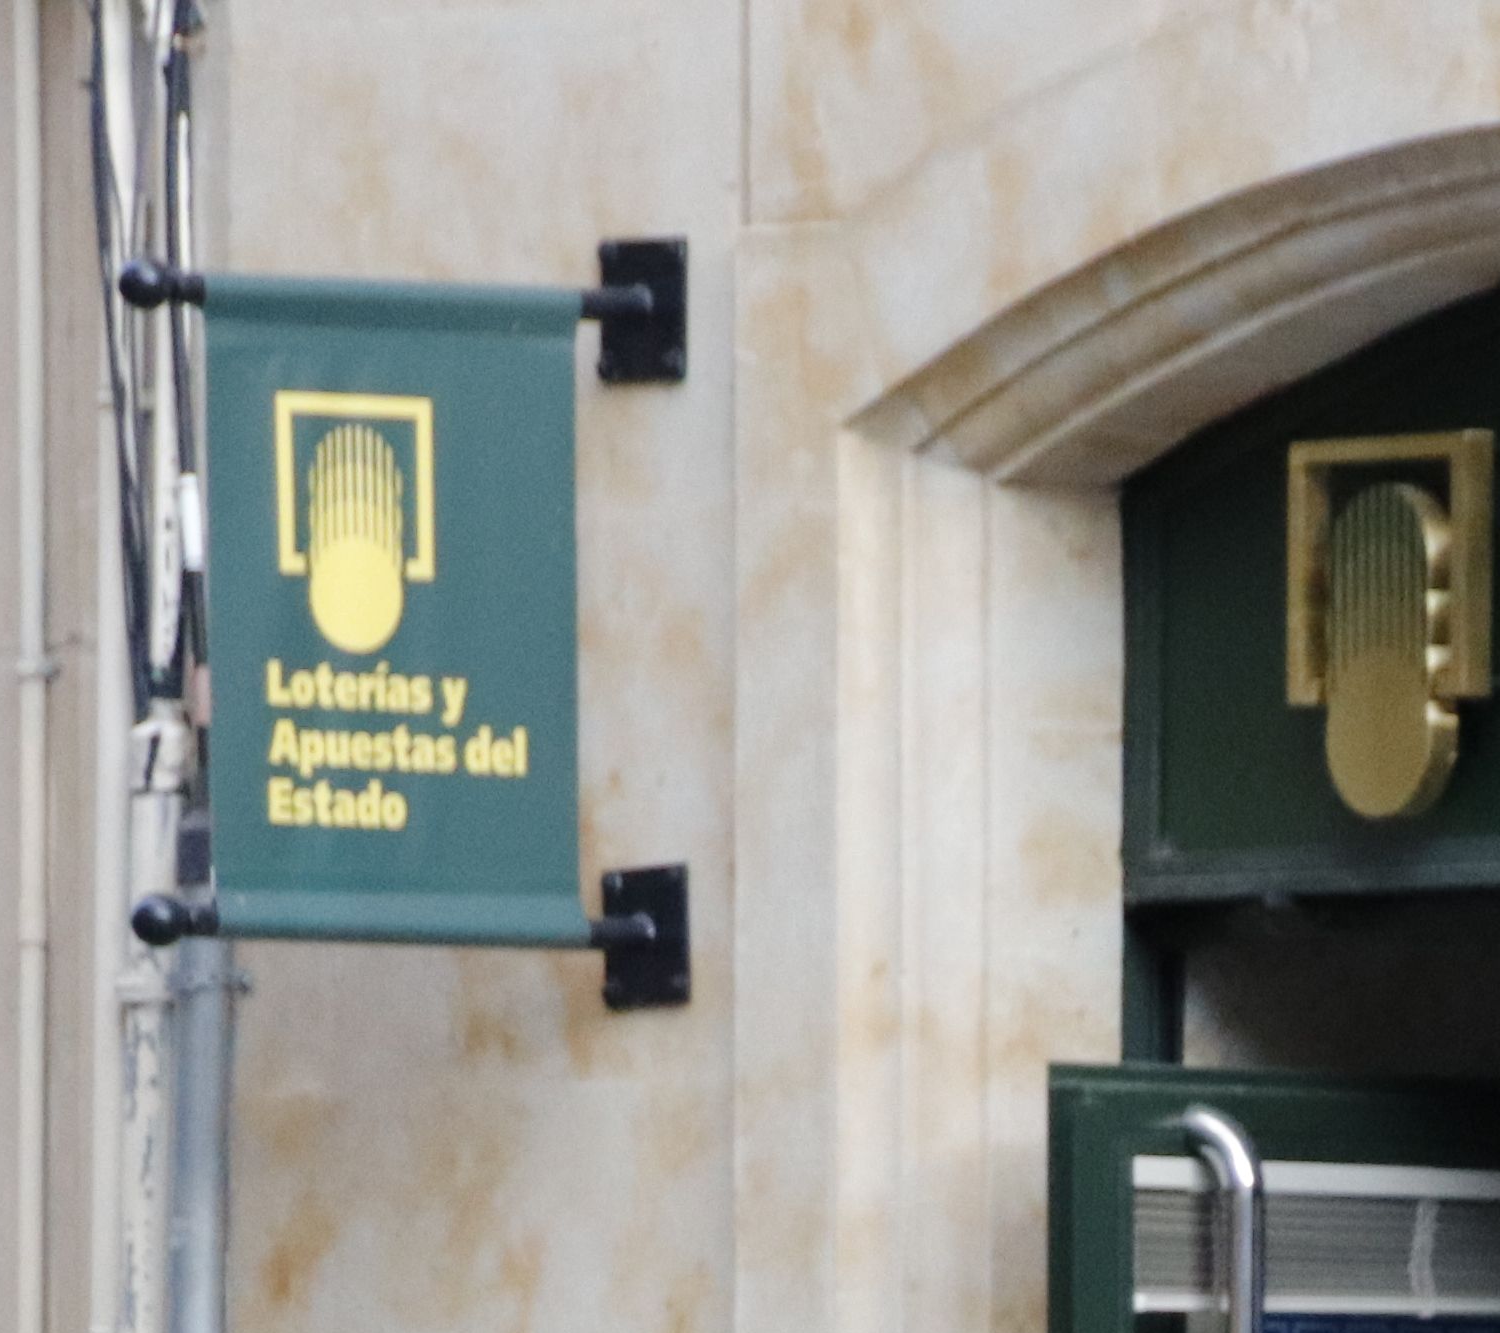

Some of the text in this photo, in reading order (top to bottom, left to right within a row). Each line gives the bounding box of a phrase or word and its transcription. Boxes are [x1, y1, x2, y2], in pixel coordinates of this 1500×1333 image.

[265, 657, 468, 728] Loterías y
[268, 717, 528, 778] Apuestas del
[267, 776, 408, 831] Estado
